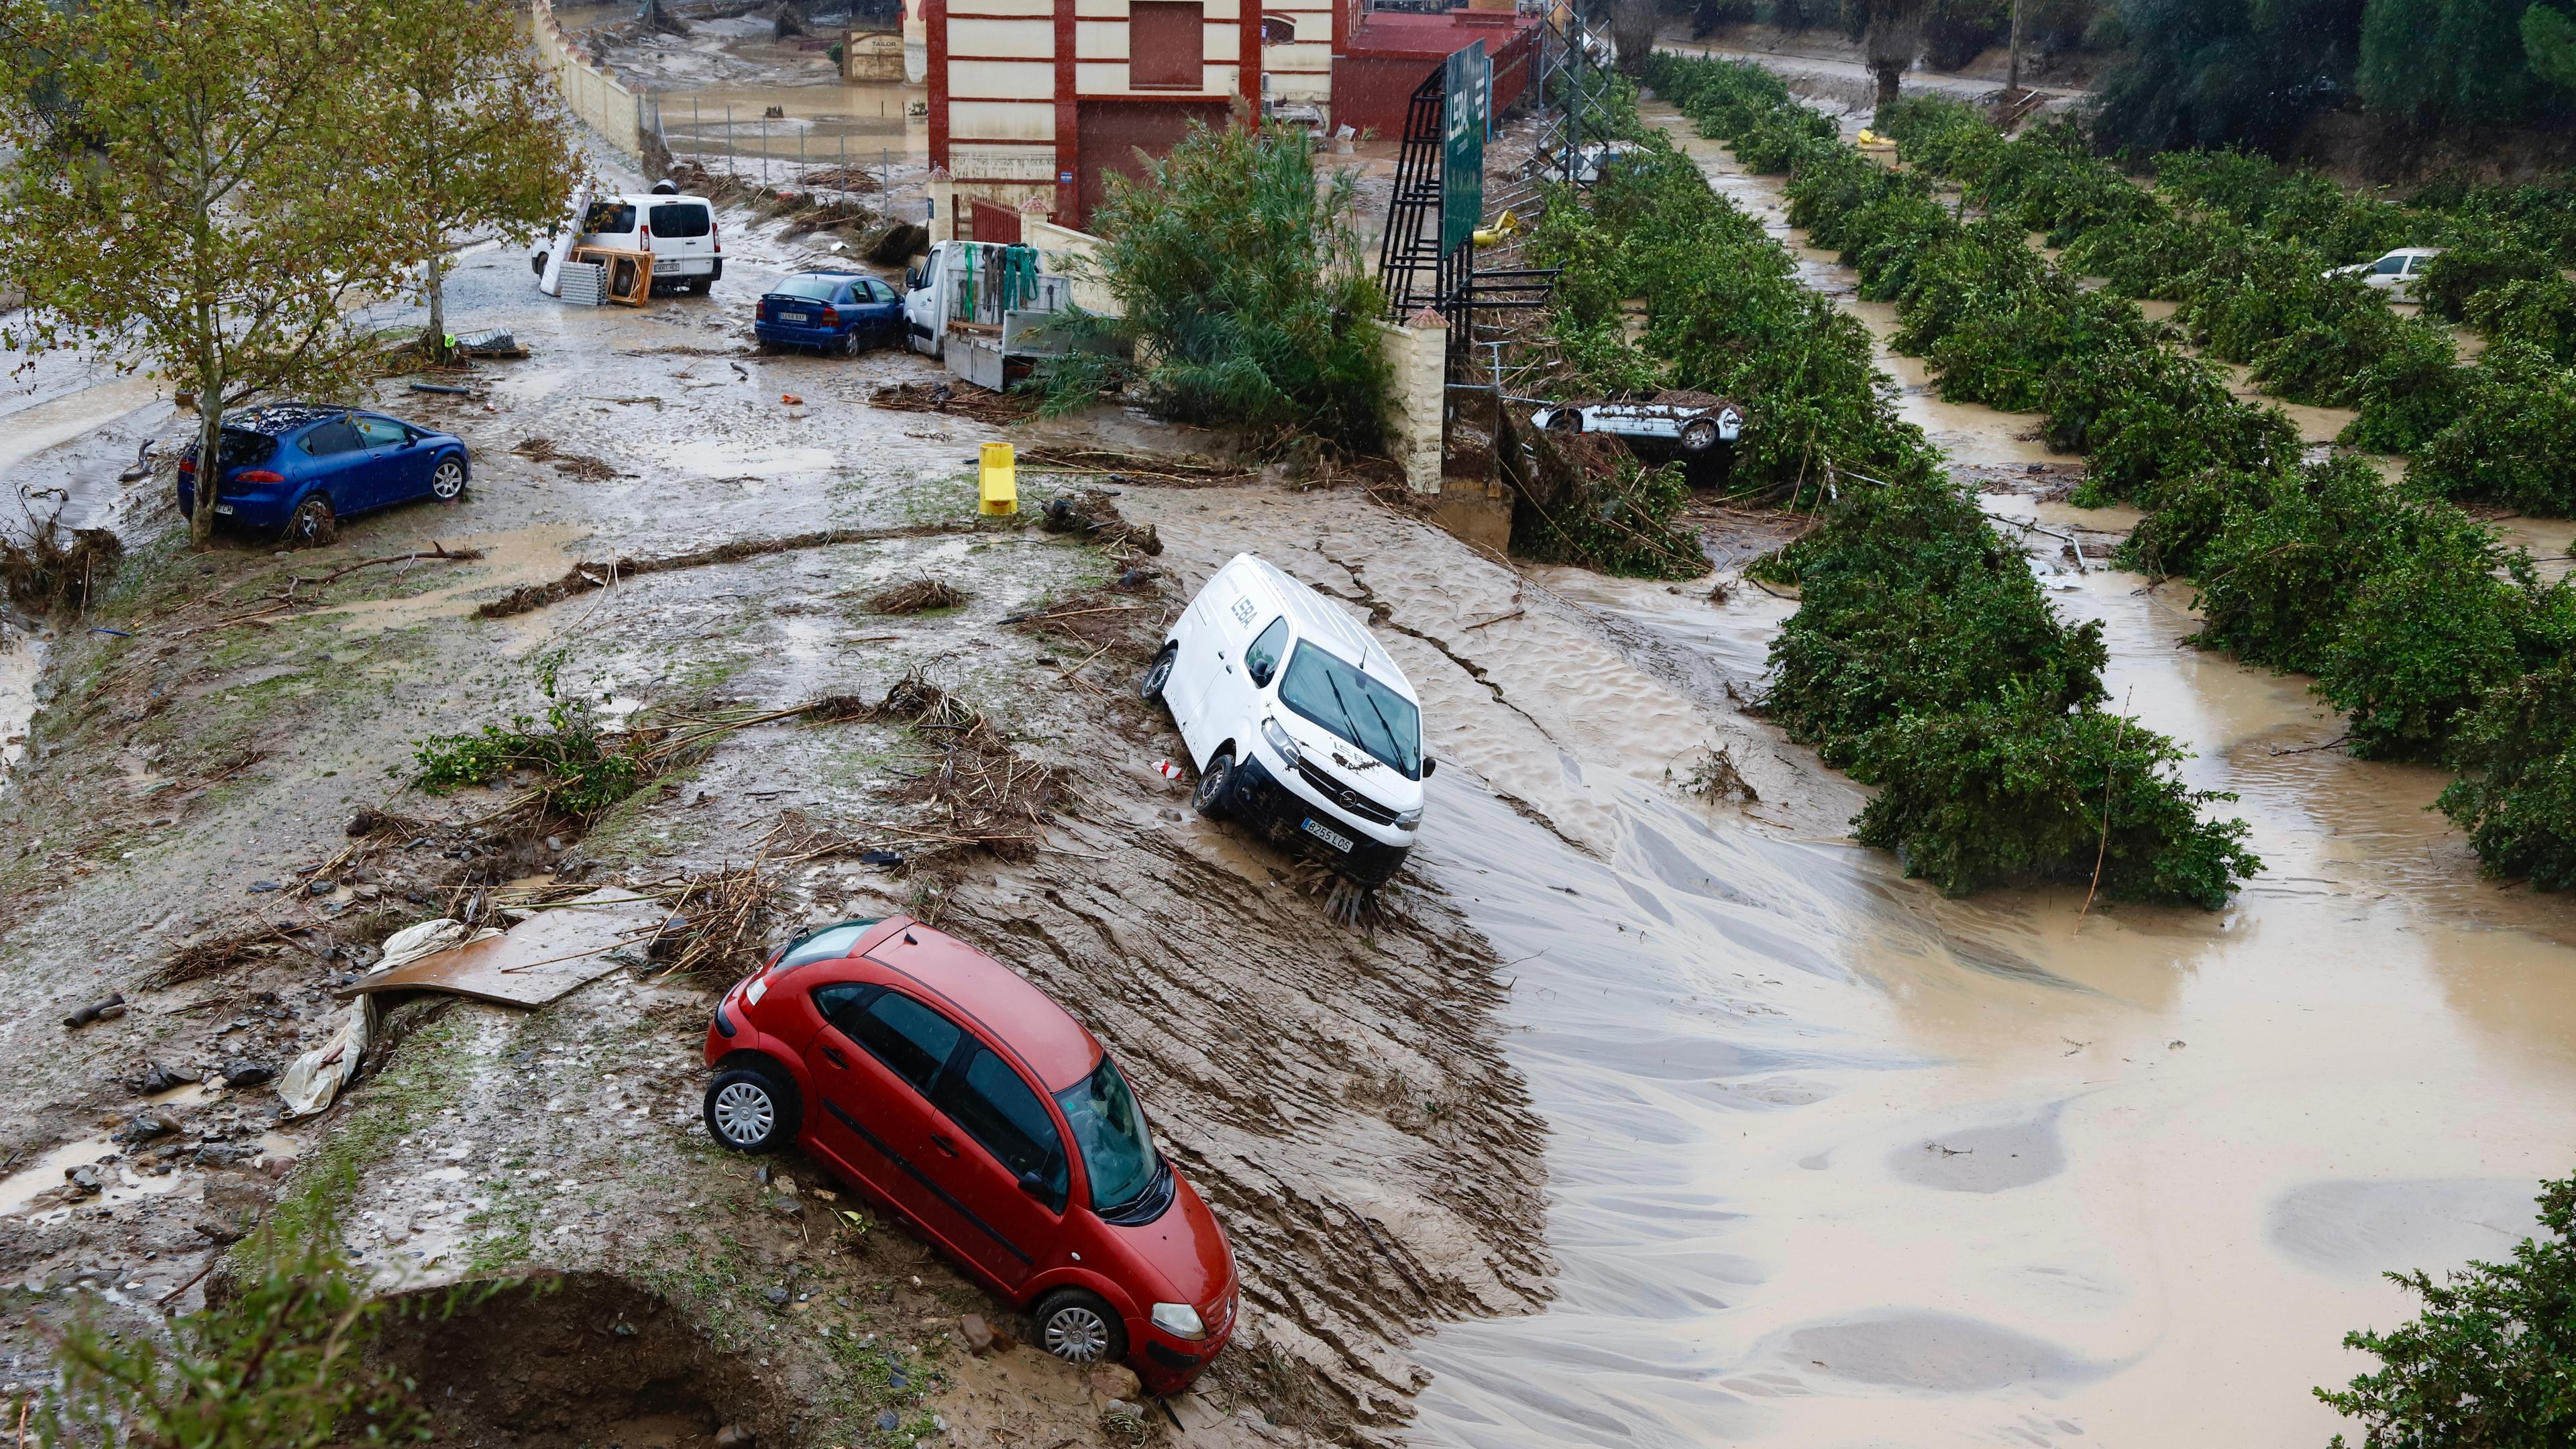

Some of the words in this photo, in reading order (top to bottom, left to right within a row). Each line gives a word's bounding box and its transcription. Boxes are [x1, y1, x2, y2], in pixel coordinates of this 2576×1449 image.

[1449, 89, 1469, 141] LEBA
[1231, 594, 1257, 629] LEBA
[1308, 822, 1332, 840] 8255
